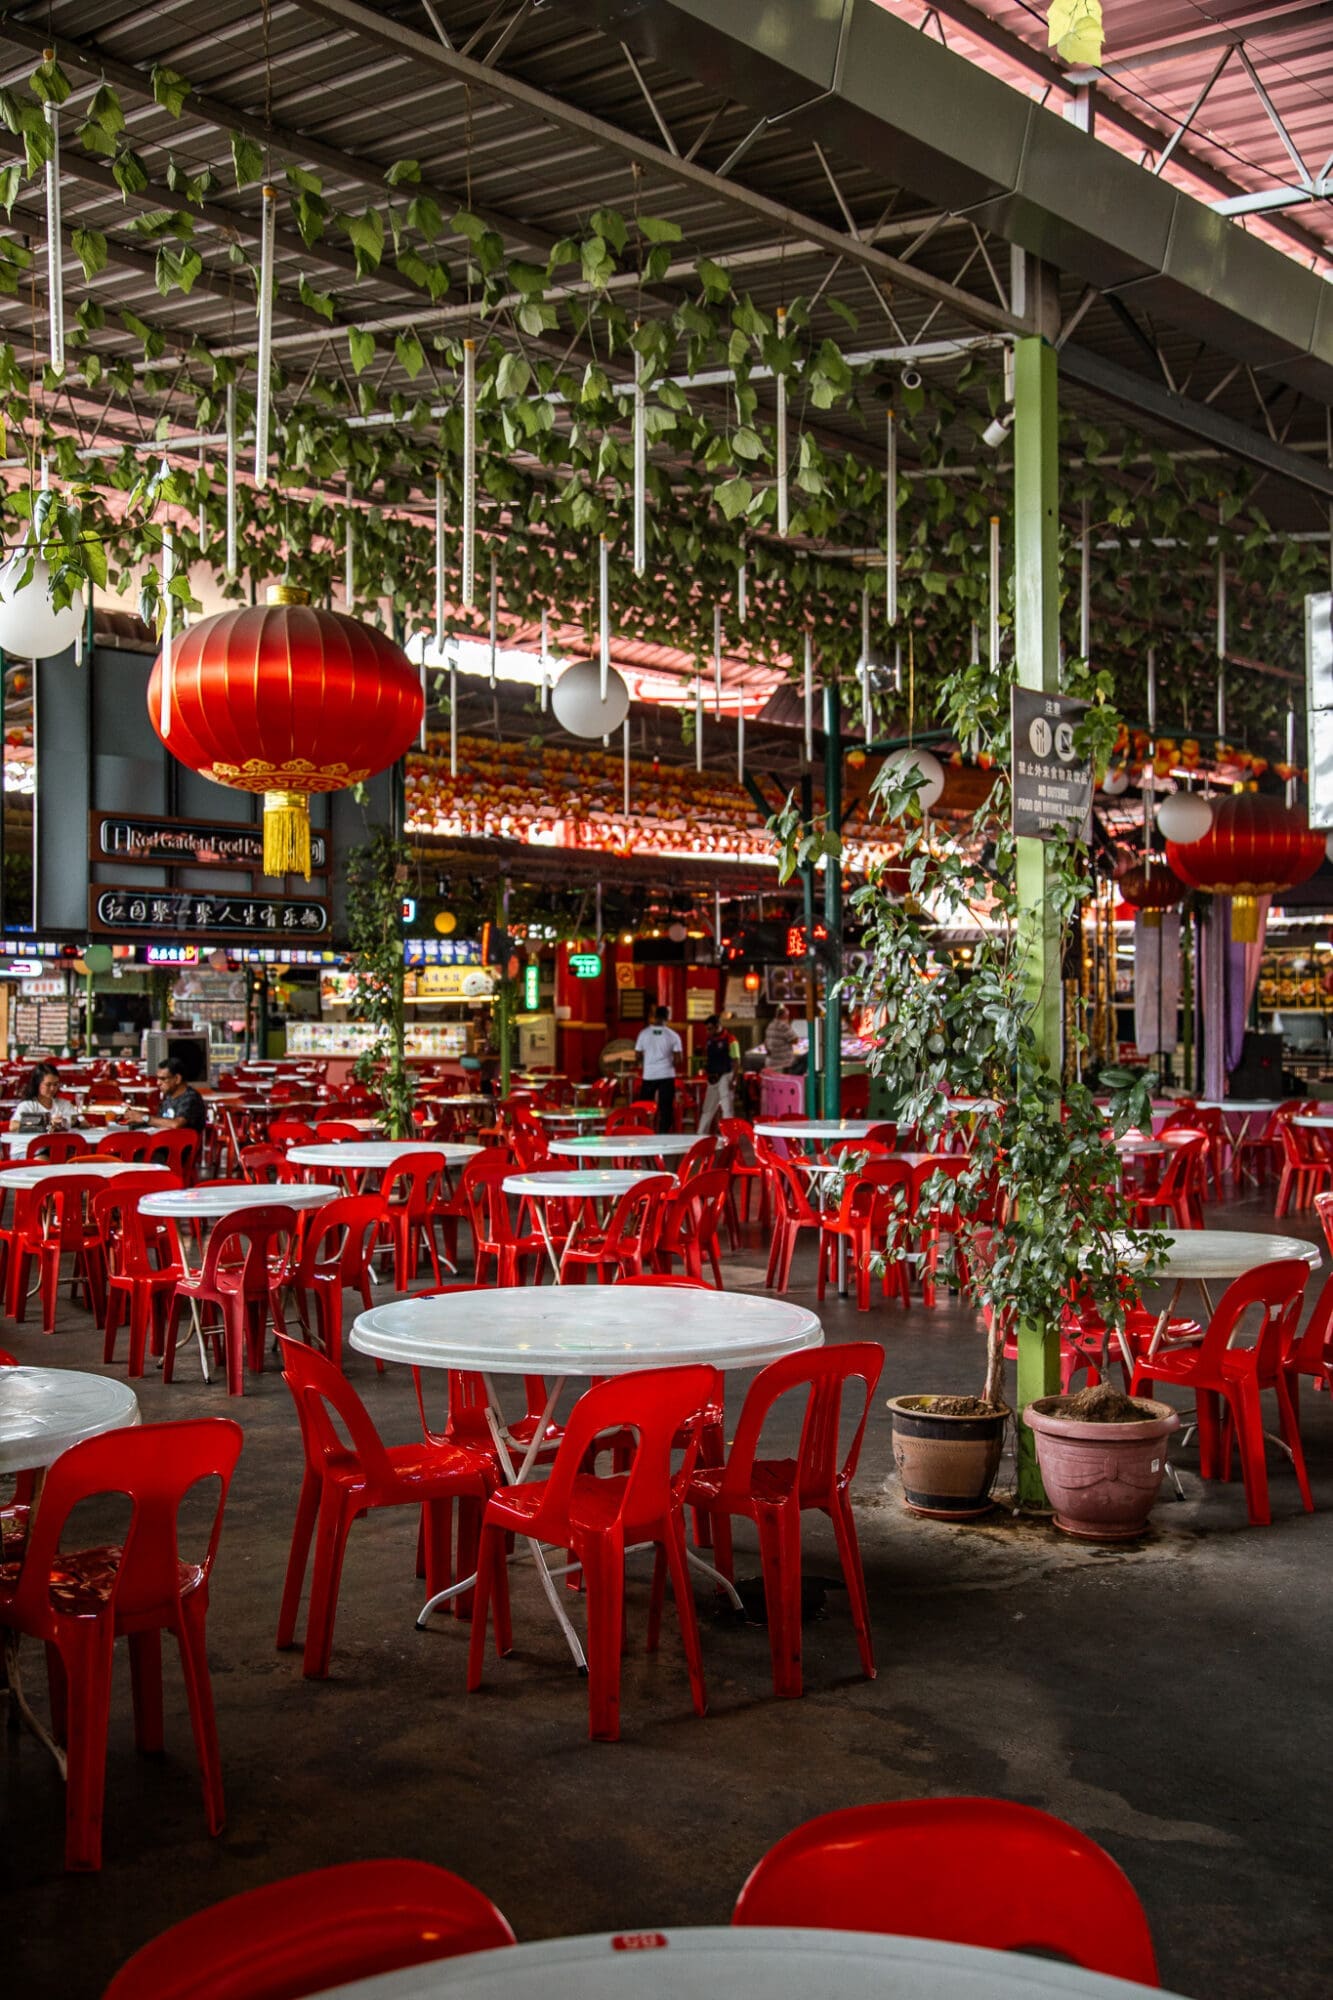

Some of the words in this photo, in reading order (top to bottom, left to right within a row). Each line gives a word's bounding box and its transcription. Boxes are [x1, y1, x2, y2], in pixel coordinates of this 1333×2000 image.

[1018, 798, 1033, 810] FOOD
[1034, 800, 1042, 812] OR
[131, 829, 158, 847] Red
[161, 832, 209, 850] Garden
[212, 836, 243, 853] Food
